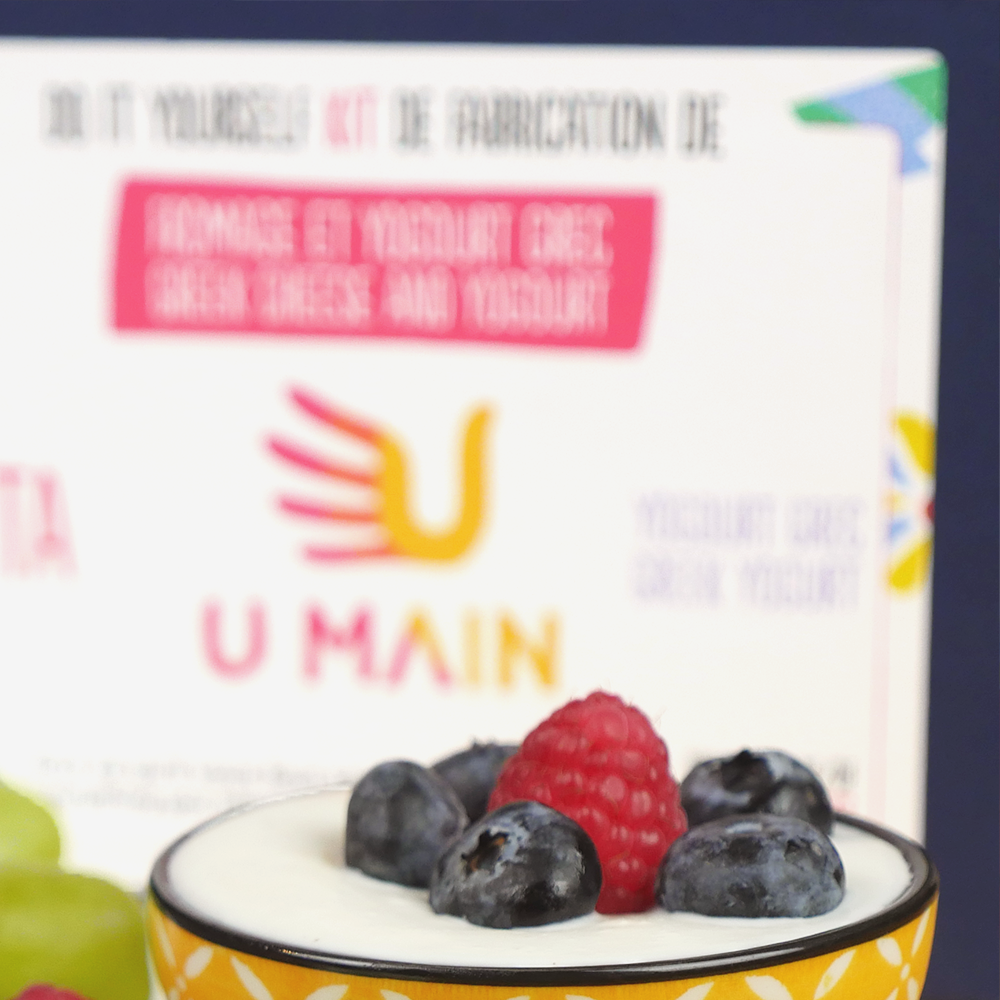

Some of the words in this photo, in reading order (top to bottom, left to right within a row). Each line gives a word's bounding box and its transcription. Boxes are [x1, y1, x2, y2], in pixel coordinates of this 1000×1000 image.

[102, 83, 134, 145] IT
[151, 84, 309, 151] YOURSELF
[446, 88, 667, 156] FABRICATION
[679, 90, 726, 159] DE
[147, 194, 296, 256] FROMAGE
[306, 197, 351, 258] ET
[359, 199, 513, 263] YOGOURT
[521, 203, 614, 267] GREC
[382, 267, 455, 330] AND
[202, 601, 266, 679] U
[301, 603, 560, 691] MAIN
